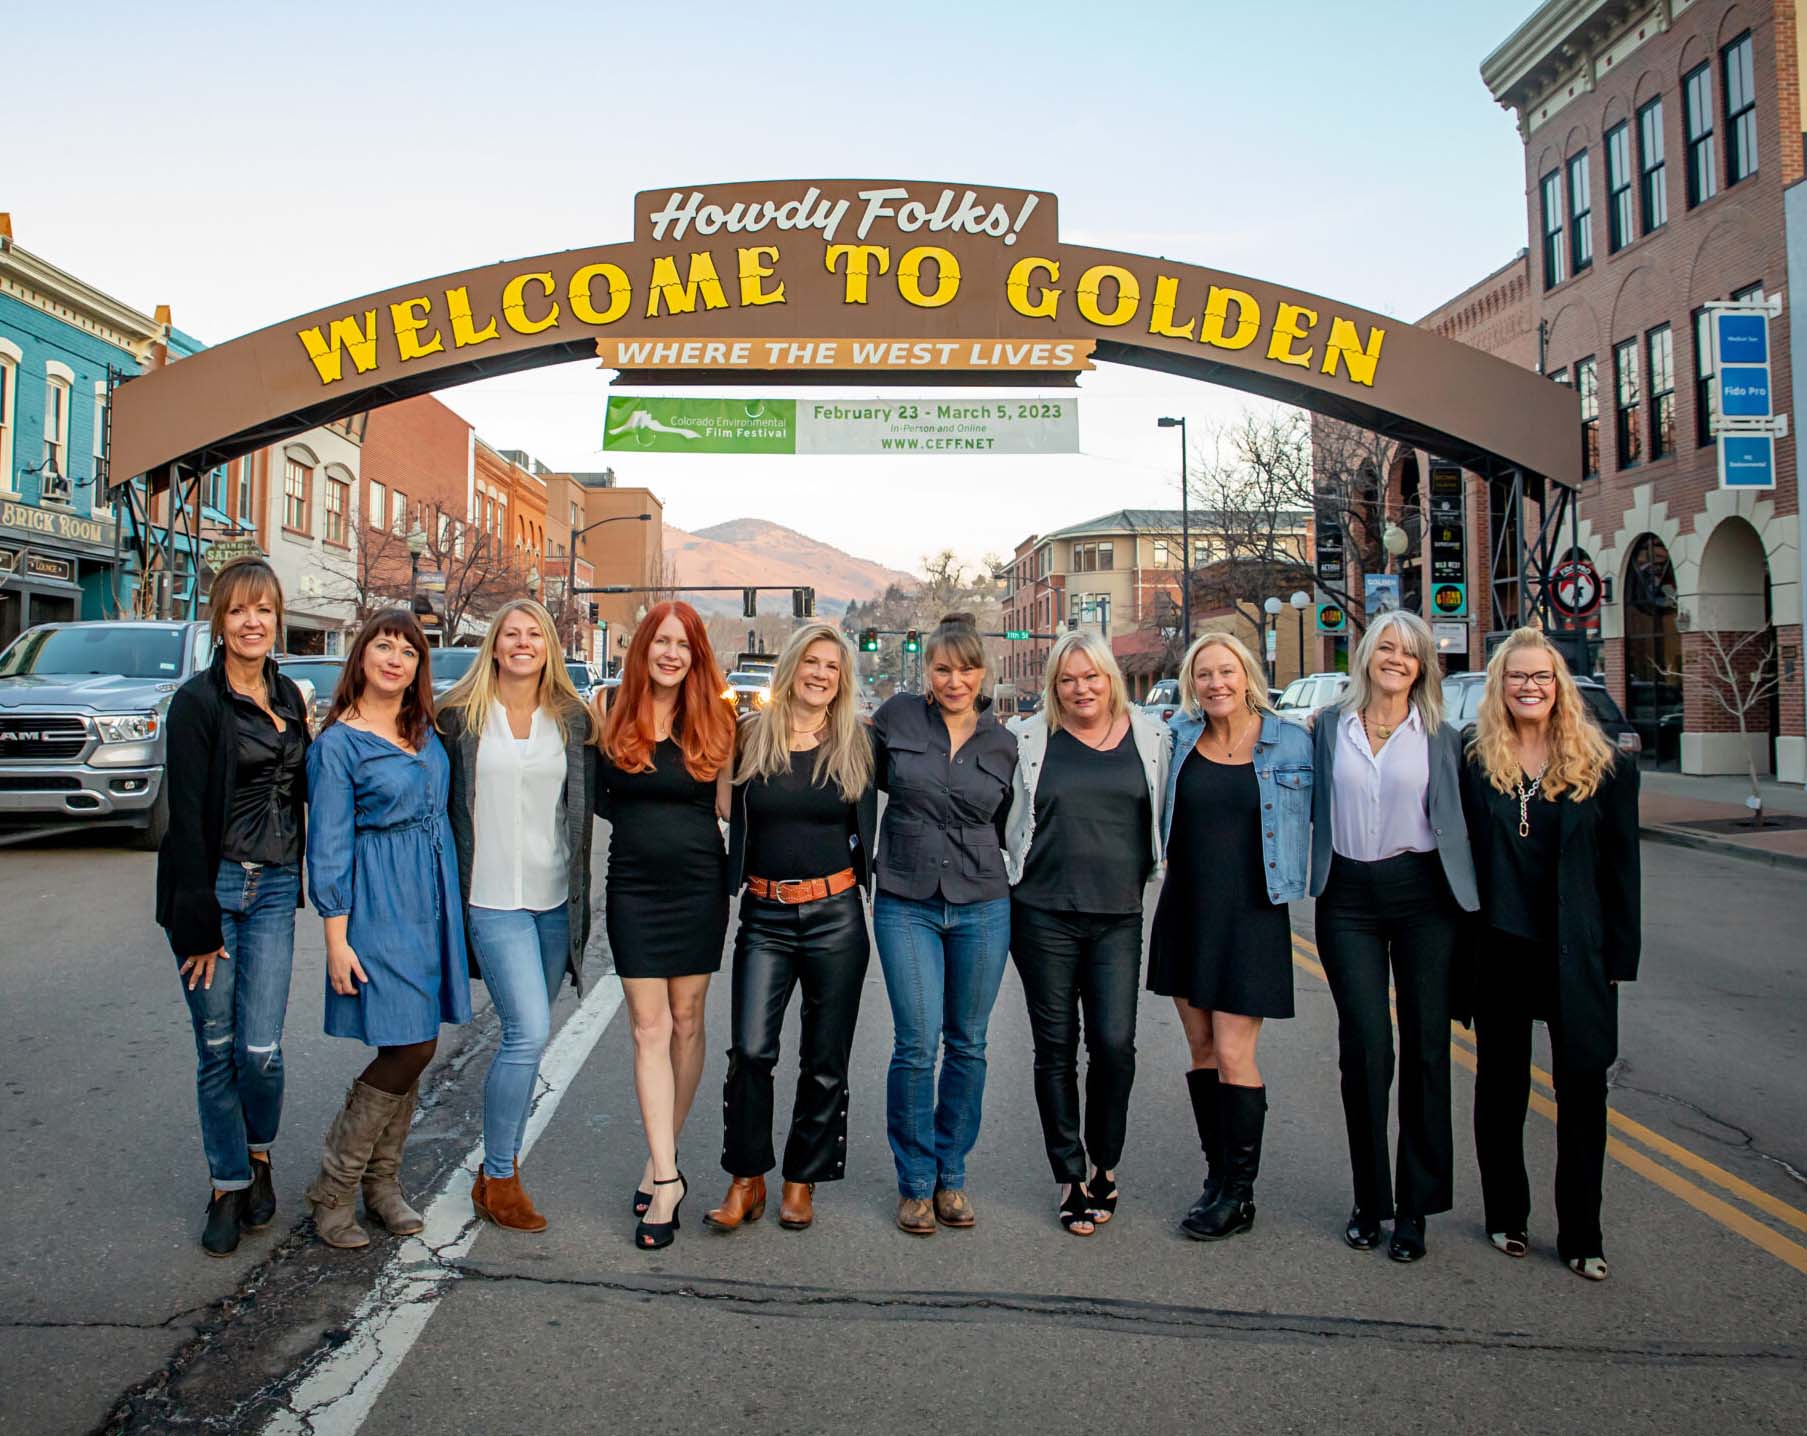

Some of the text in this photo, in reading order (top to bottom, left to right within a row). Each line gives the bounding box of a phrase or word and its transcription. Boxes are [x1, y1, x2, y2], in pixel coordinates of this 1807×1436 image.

[649, 186, 1040, 247] Howdy Folks!
[297, 243, 1387, 388] WELCOME TO GOLDEN
[616, 342, 1076, 366] WHERE THE WEST LIVES
[1725, 386, 1766, 396] Fido Pro
[670, 415, 786, 427] Colorado Environmental
[814, 405, 892, 423] February
[898, 406, 919, 420] 23
[937, 405, 990, 420] March
[997, 405, 1012, 421] 5,
[1018, 405, 1062, 419] 2023
[706, 428, 787, 438] Film Festival
[890, 424, 987, 433] In-Person and Online
[2, 503, 102, 541] BRICK ROOM
[0, 731, 39, 741] AM
